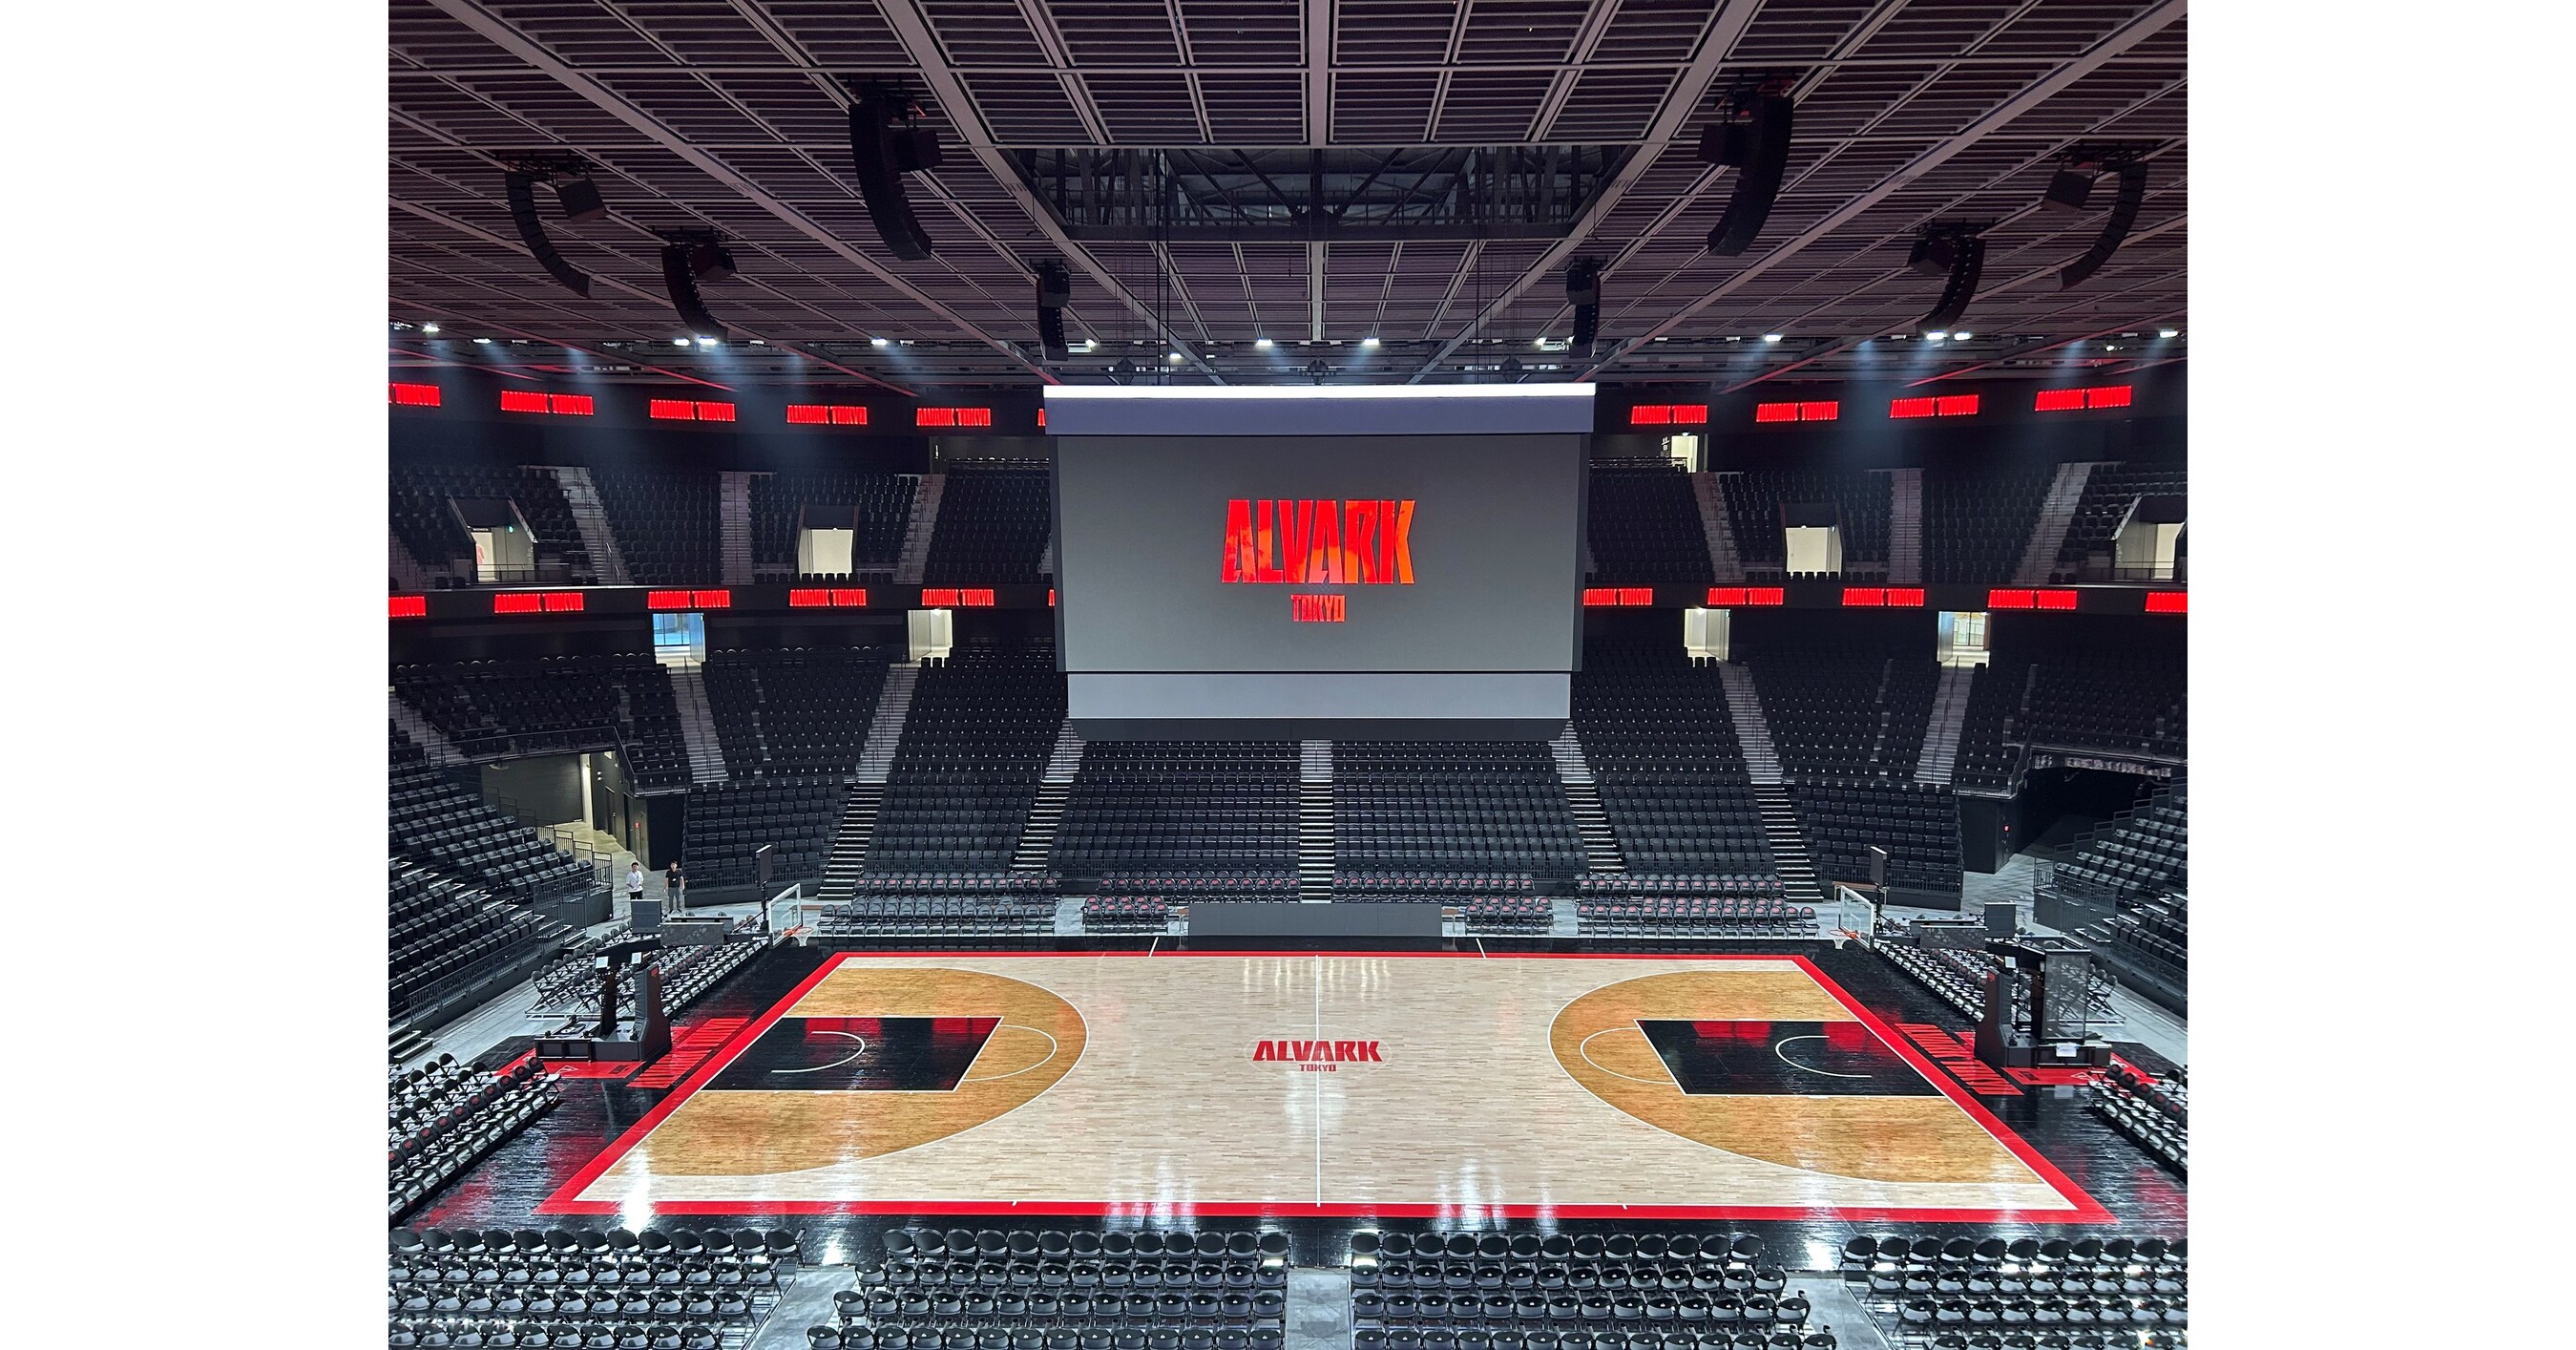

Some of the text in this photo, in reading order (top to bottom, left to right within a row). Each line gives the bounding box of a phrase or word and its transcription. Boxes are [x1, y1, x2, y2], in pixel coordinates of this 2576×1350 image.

[1221, 498, 1415, 585] ALVARK
[922, 589, 994, 606] ALVARK TOKYO
[1290, 594, 1346, 622] TOKYO
[1252, 1040, 1383, 1062] ALVARK
[1299, 1064, 1337, 1072] TOKYO
